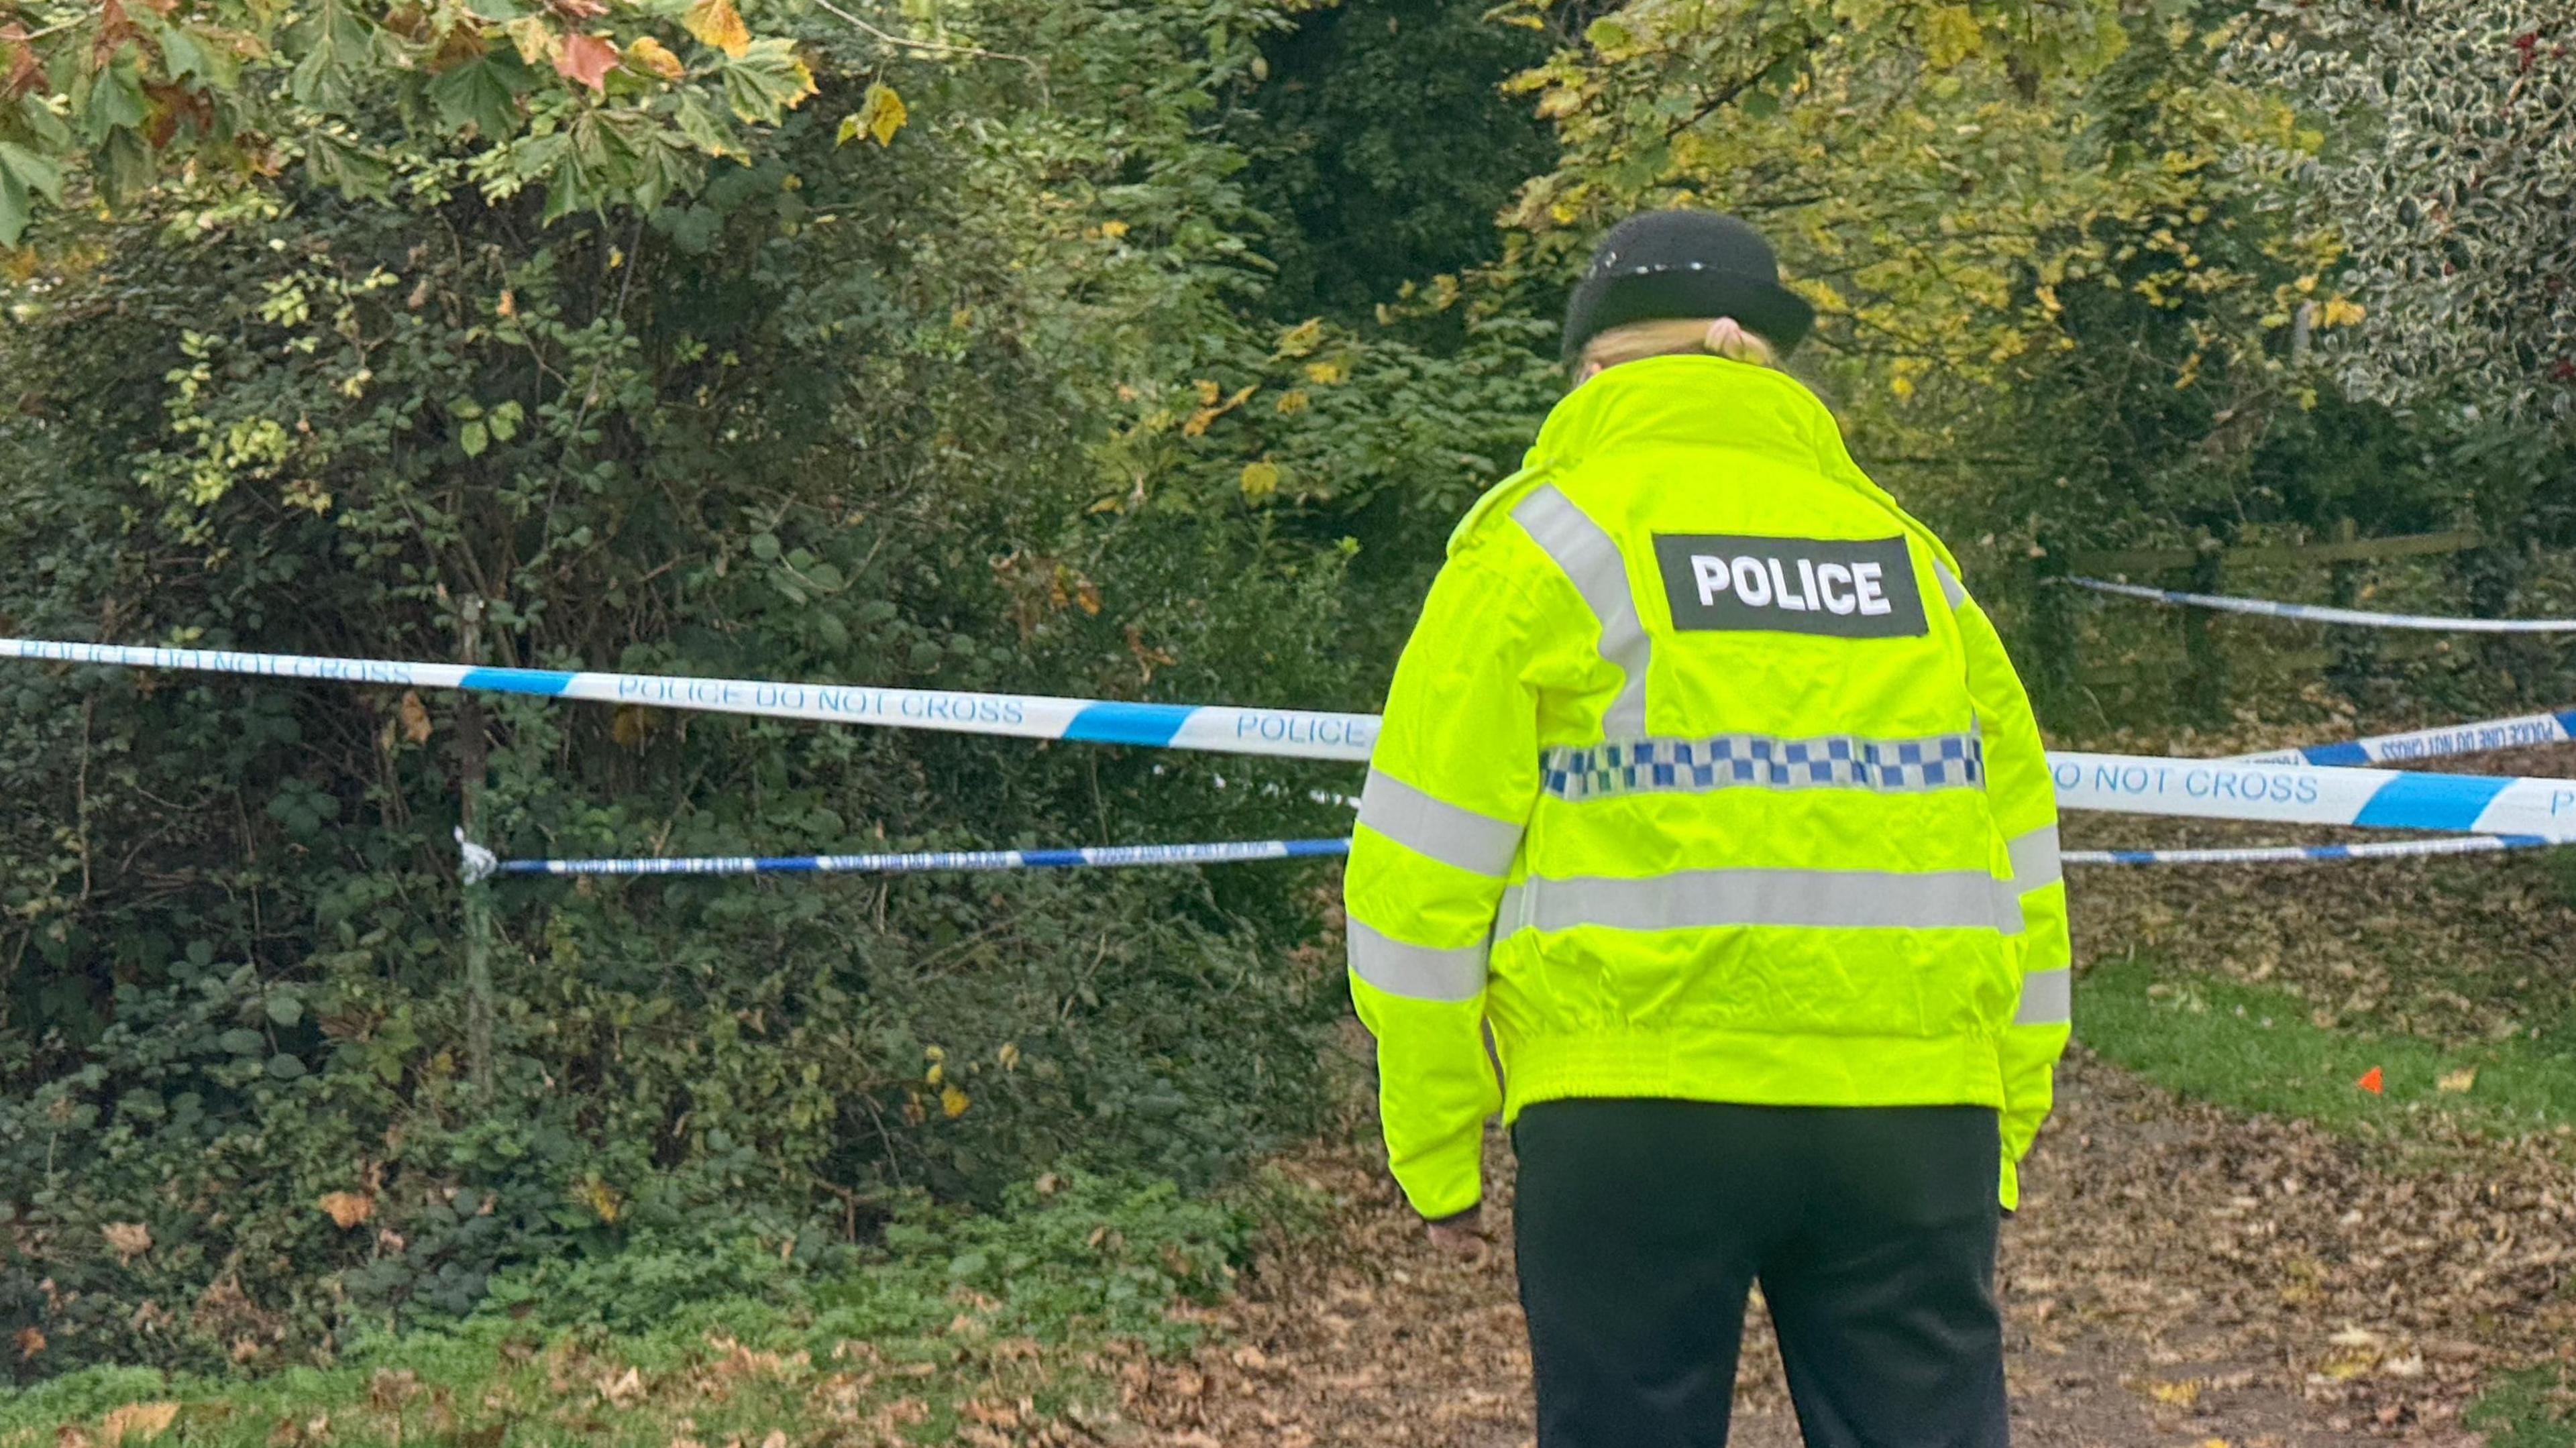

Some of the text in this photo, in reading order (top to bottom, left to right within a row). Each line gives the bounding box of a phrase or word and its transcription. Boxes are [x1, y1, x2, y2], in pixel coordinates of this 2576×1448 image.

[1690, 555, 1892, 616] POLICE
[619, 676, 1024, 724] POLICE DO NOT CROSS
[1237, 714, 1366, 747] POLICE
[2048, 761, 2318, 804] O NOT CROSS
